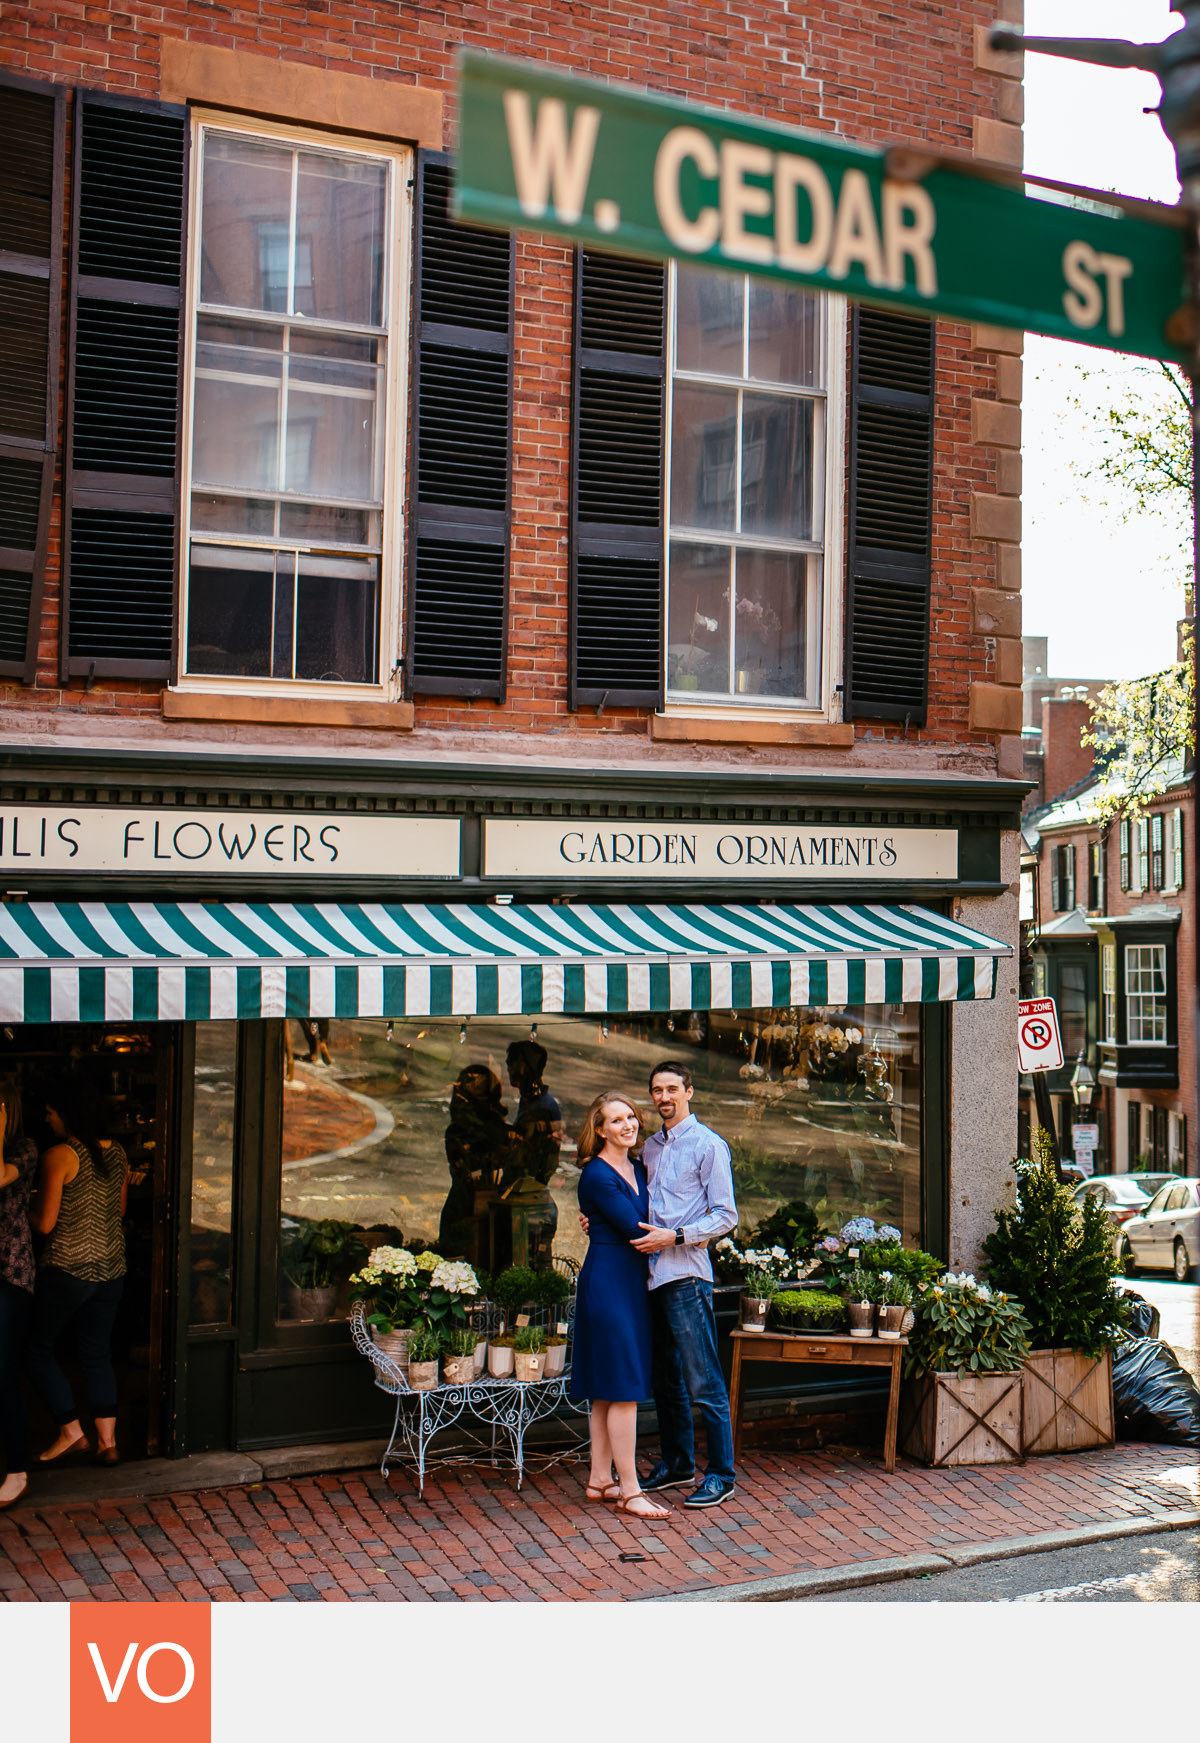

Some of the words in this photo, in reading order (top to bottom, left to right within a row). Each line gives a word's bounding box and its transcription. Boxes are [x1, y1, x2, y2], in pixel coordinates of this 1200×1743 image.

[505, 91, 620, 231] W.
[654, 126, 937, 297] CEDAR
[1062, 240, 1134, 337] ST
[0, 816, 81, 857] LIS
[123, 820, 341, 862] FLOWERS
[559, 832, 697, 864] GARDEN
[716, 835, 898, 867] ORNAMENTS
[1018, 1005, 1029, 1014] OW
[1033, 1002, 1052, 1012] ZONE
